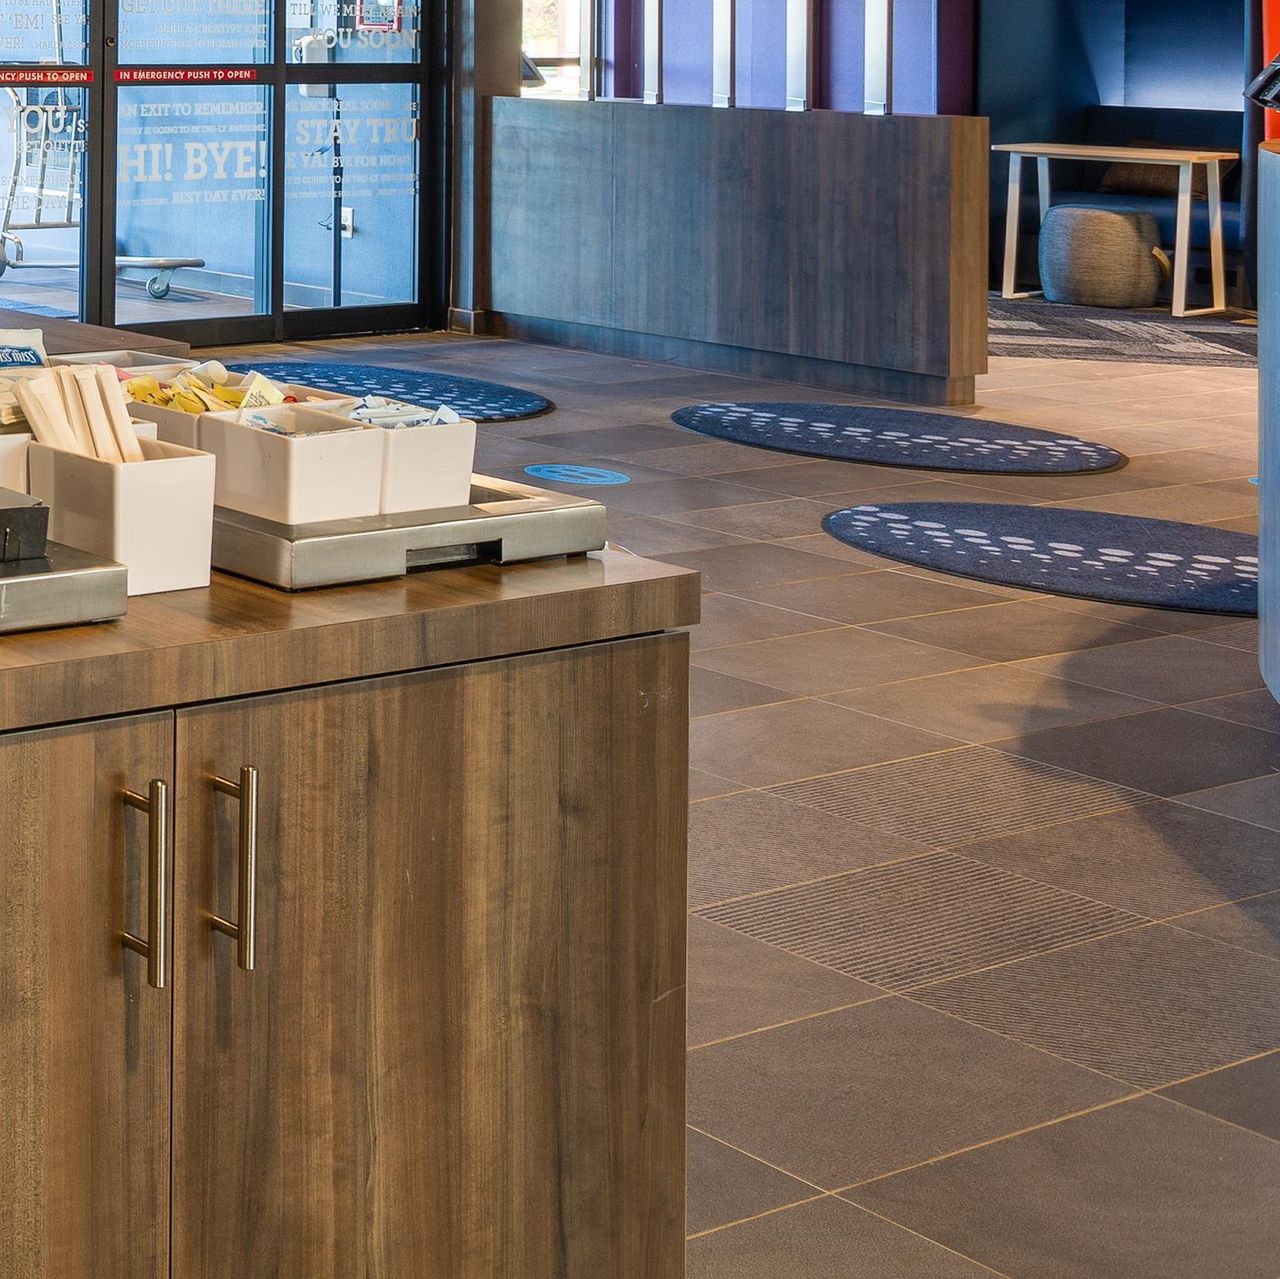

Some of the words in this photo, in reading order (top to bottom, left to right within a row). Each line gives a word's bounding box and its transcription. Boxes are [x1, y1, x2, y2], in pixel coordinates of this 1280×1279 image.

[320, 4, 340, 16] WE
[19, 72, 43, 81] PUSH
[46, 72, 59, 81] TO
[62, 72, 87, 81] OPEN
[119, 71, 130, 80] IN
[133, 70, 185, 80] EMERGENCY
[187, 71, 210, 79] PUSH
[212, 70, 225, 80] TO
[227, 70, 251, 79] OPEN
[140, 103, 170, 117] EXIT
[173, 103, 192, 116] TO
[295, 118, 360, 145] STAY
[367, 118, 417, 144] TRU
[119, 143, 173, 183] HI!
[184, 140, 267, 180] BYE!
